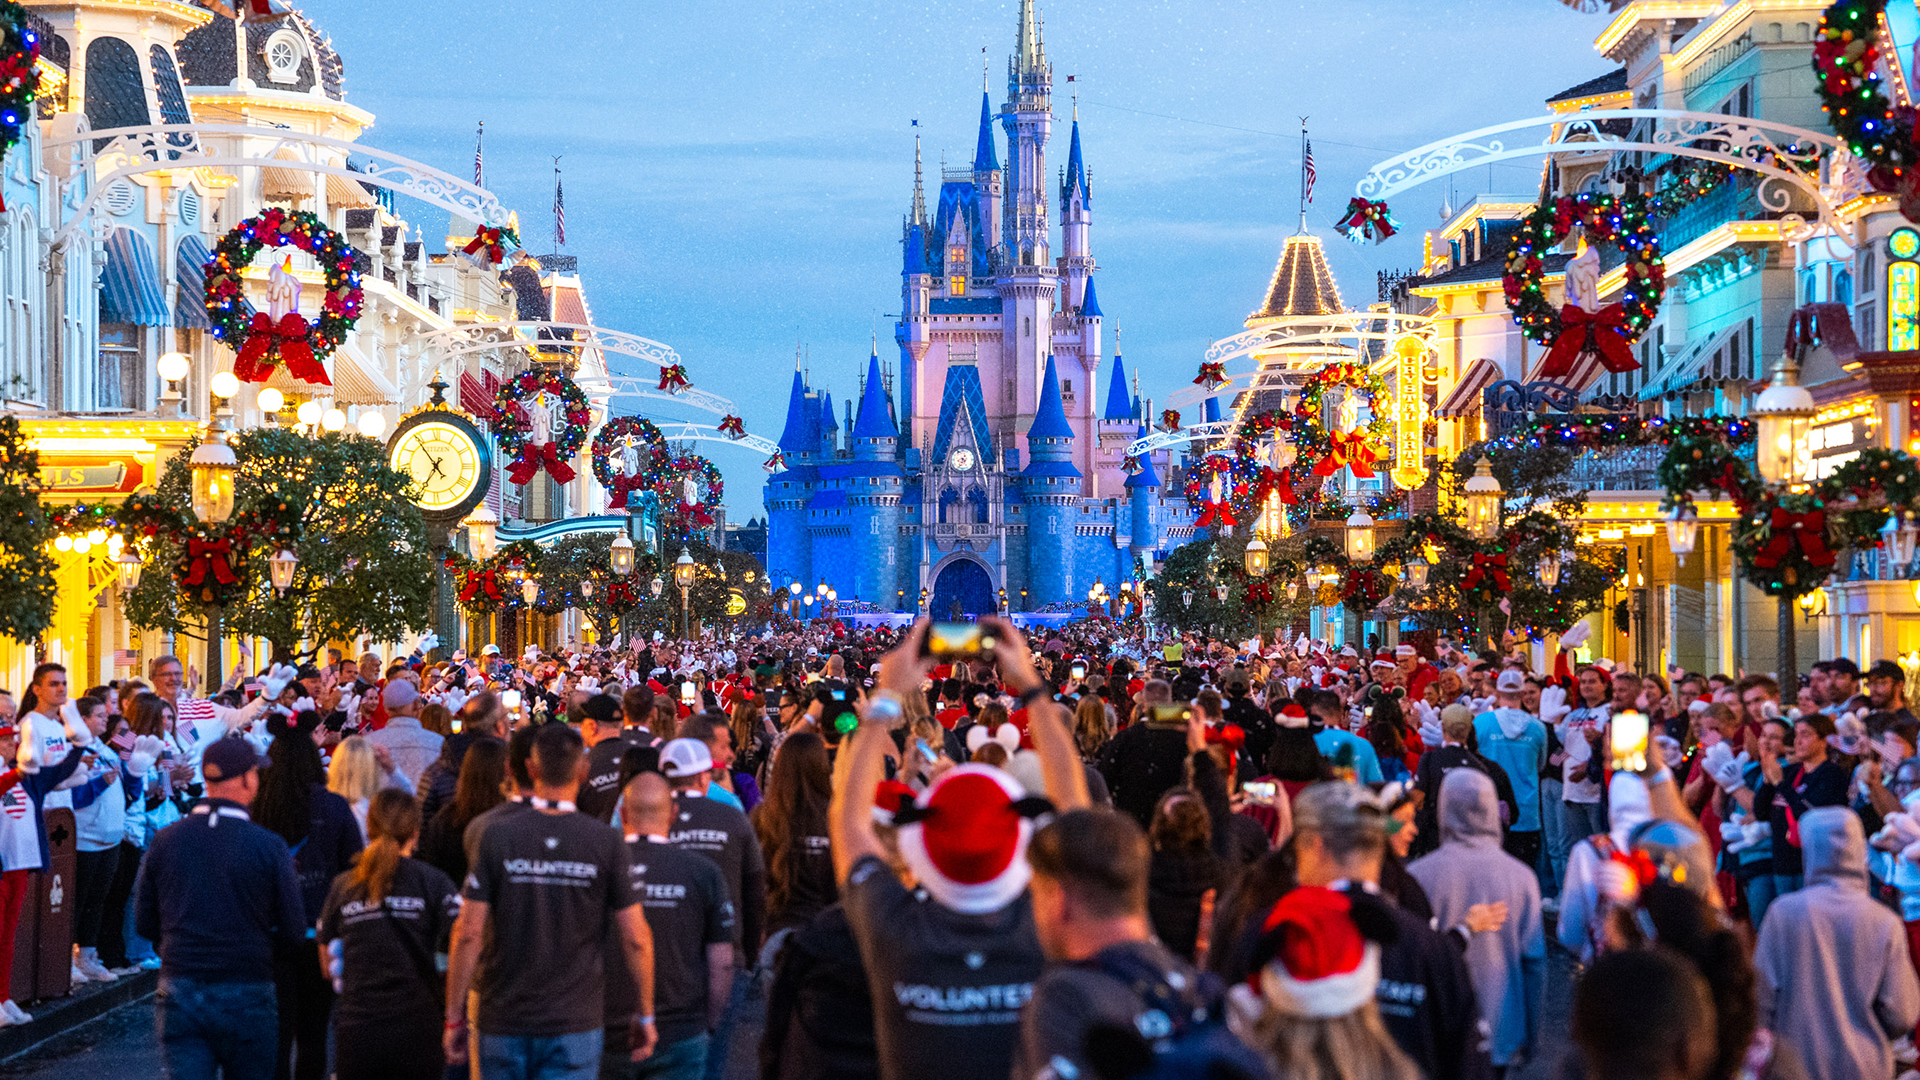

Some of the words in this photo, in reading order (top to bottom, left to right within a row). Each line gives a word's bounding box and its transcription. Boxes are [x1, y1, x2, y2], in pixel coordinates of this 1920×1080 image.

[1402, 356, 1417, 421] CRYSTAL
[1402, 431, 1417, 468] ARTS
[670, 829, 729, 843] UNTEER
[503, 858, 598, 879] VOLUNTEER
[893, 981, 1034, 1012] VOLUNTEE
